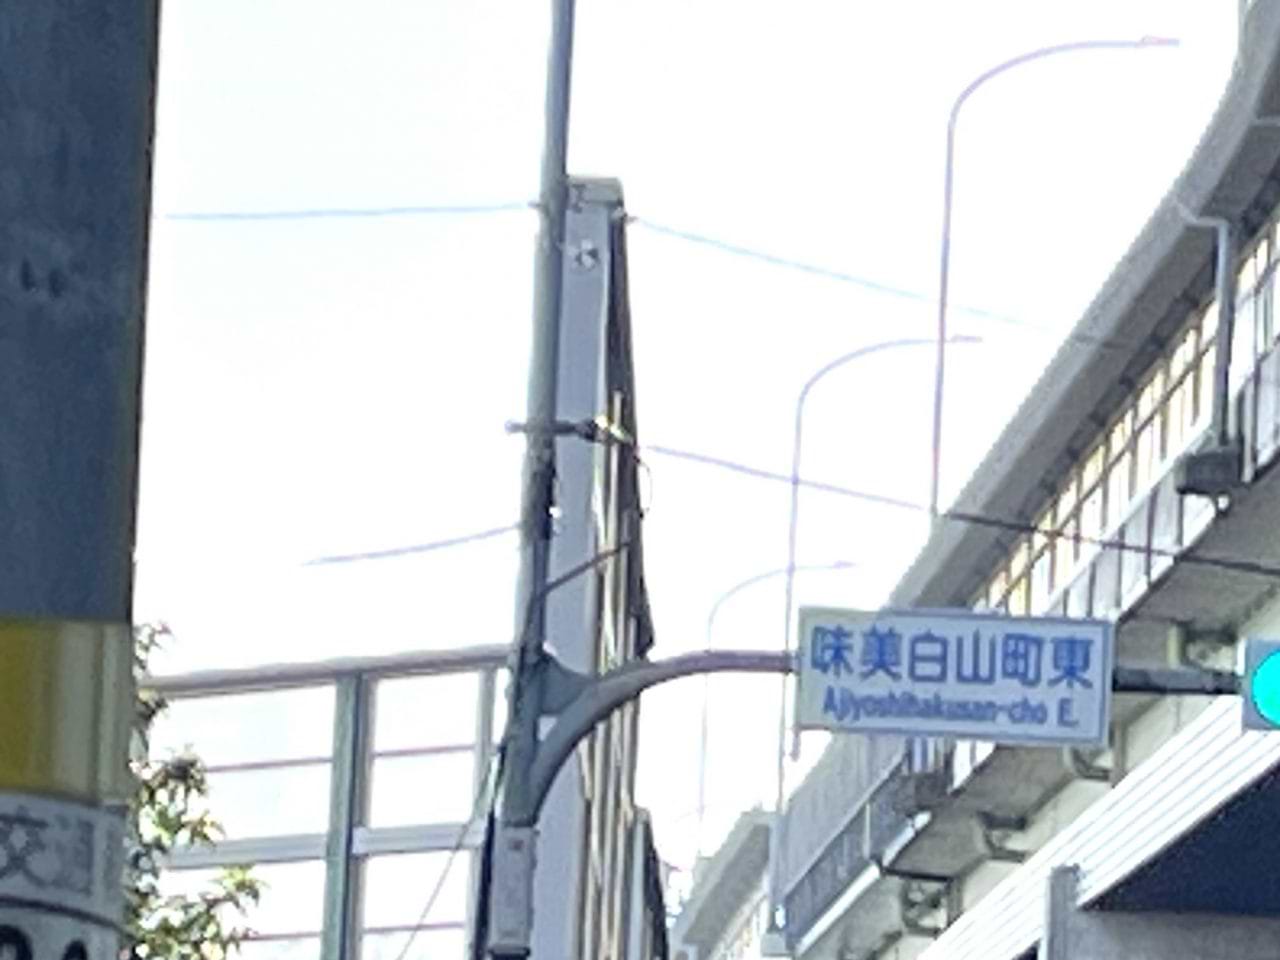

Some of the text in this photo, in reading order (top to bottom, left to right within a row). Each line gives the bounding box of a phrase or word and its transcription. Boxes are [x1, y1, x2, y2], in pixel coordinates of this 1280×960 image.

[811, 623, 1094, 689] 味美白山町東
